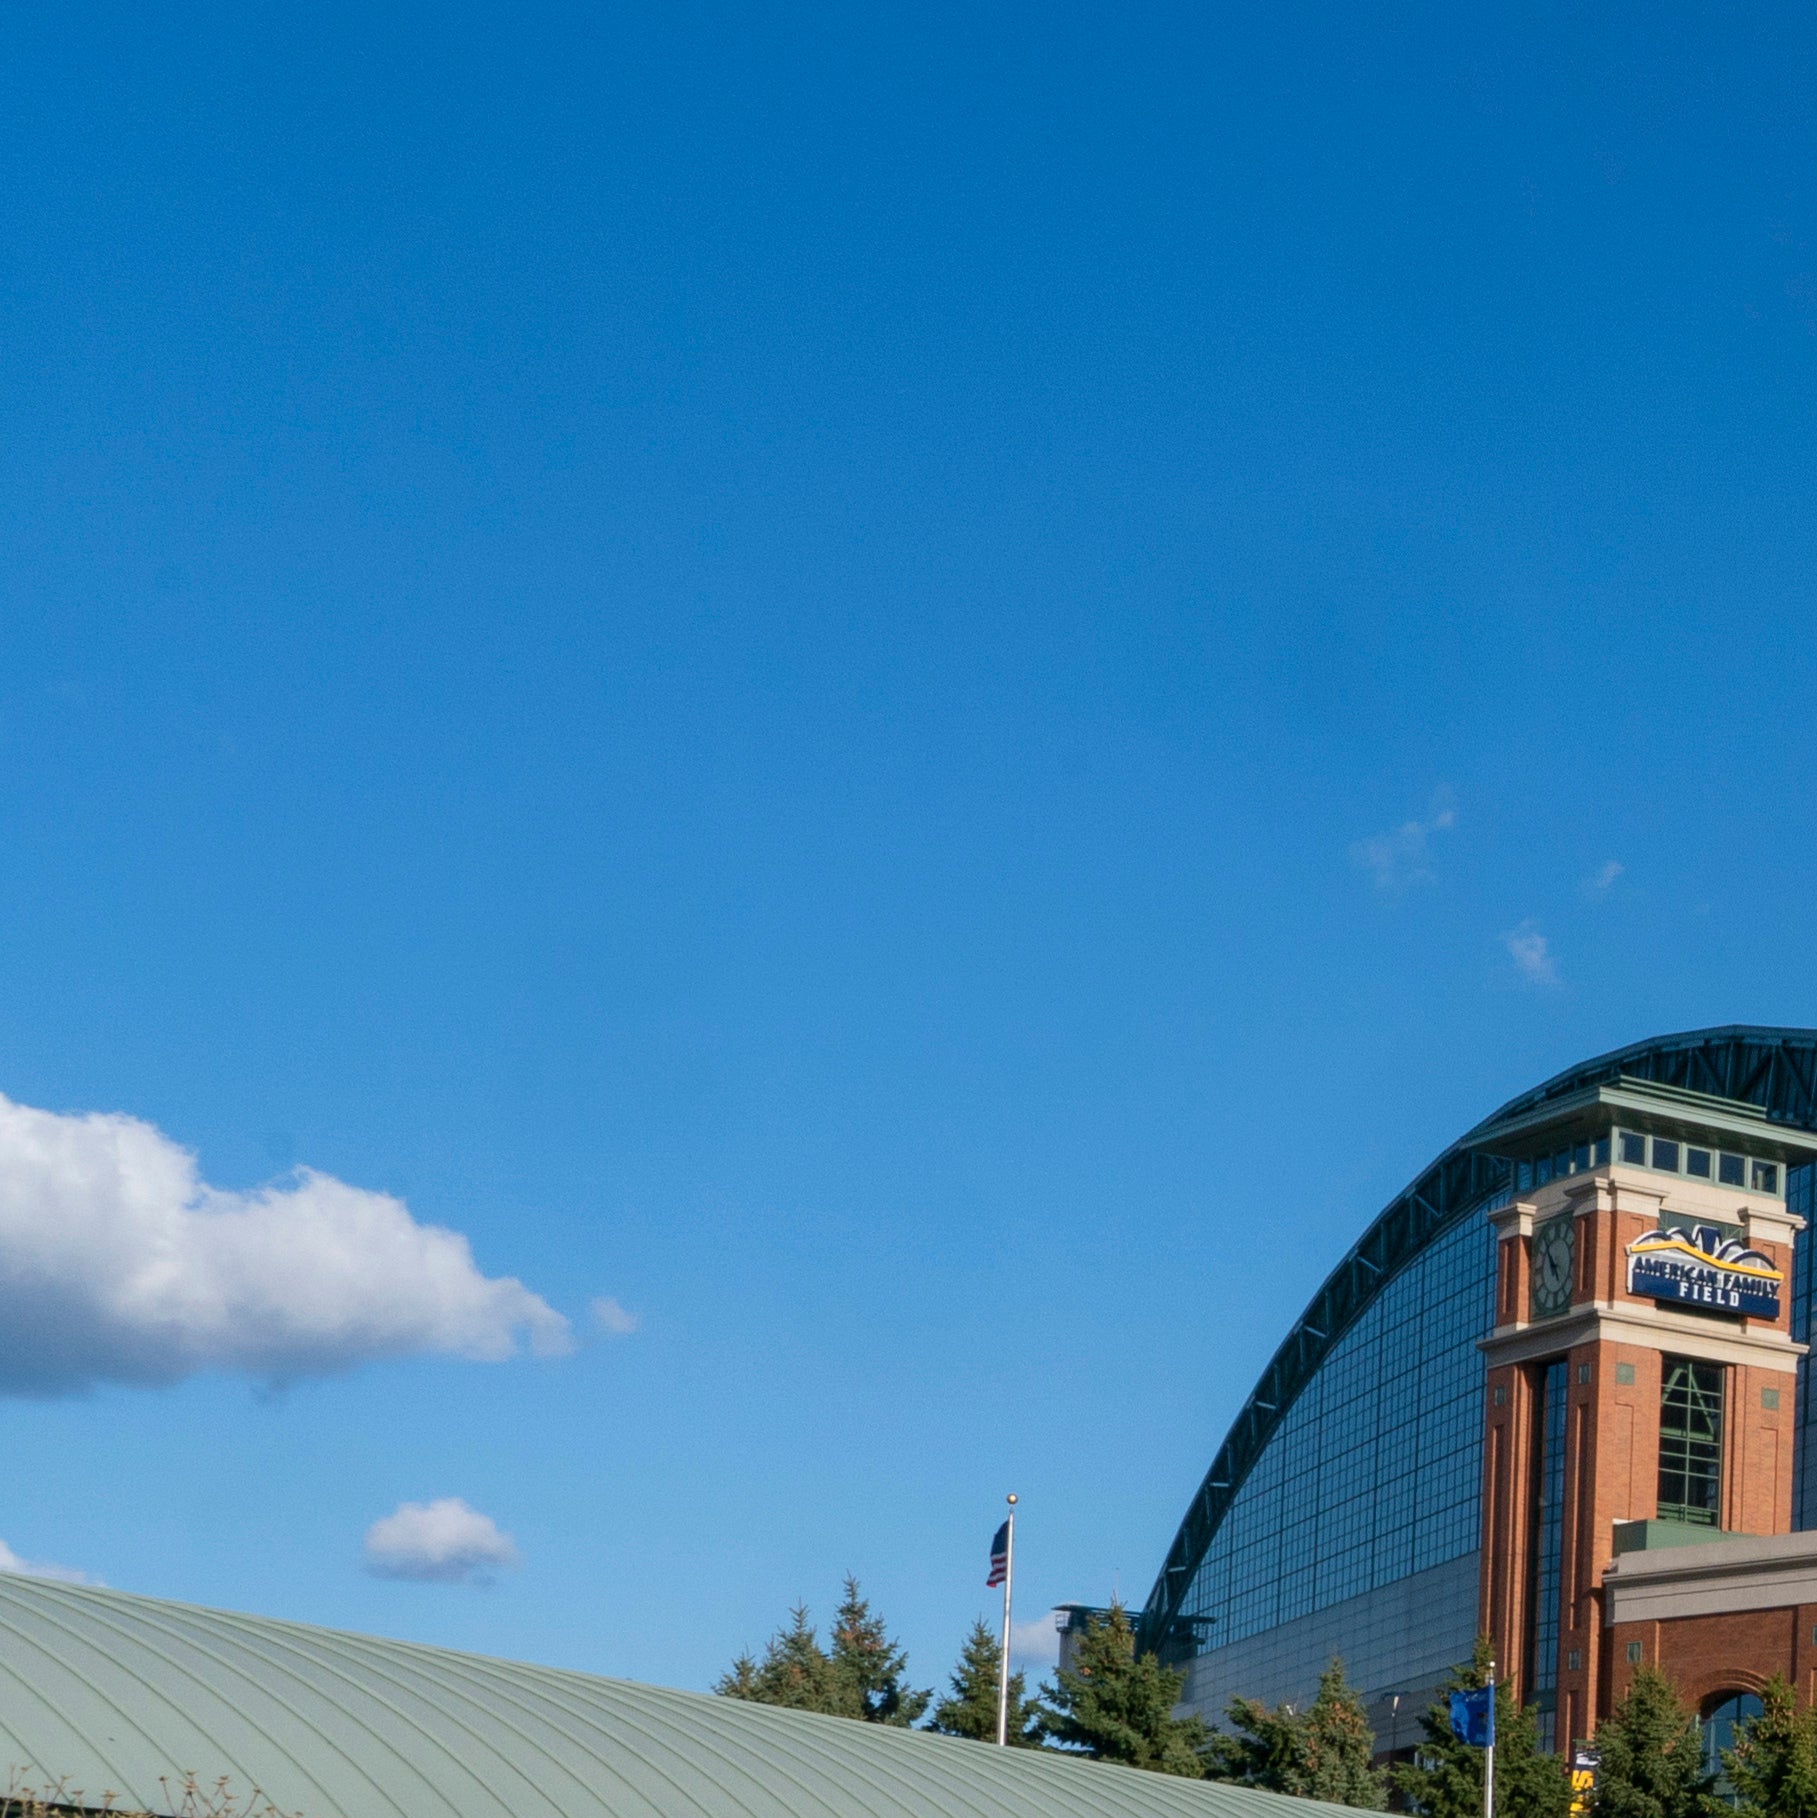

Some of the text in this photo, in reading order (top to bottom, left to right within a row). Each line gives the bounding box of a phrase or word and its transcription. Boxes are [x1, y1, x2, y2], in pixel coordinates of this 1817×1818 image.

[1633, 1256, 1780, 1296] AMERICAN FAMILY
[1679, 1282, 1740, 1307] FIELD
